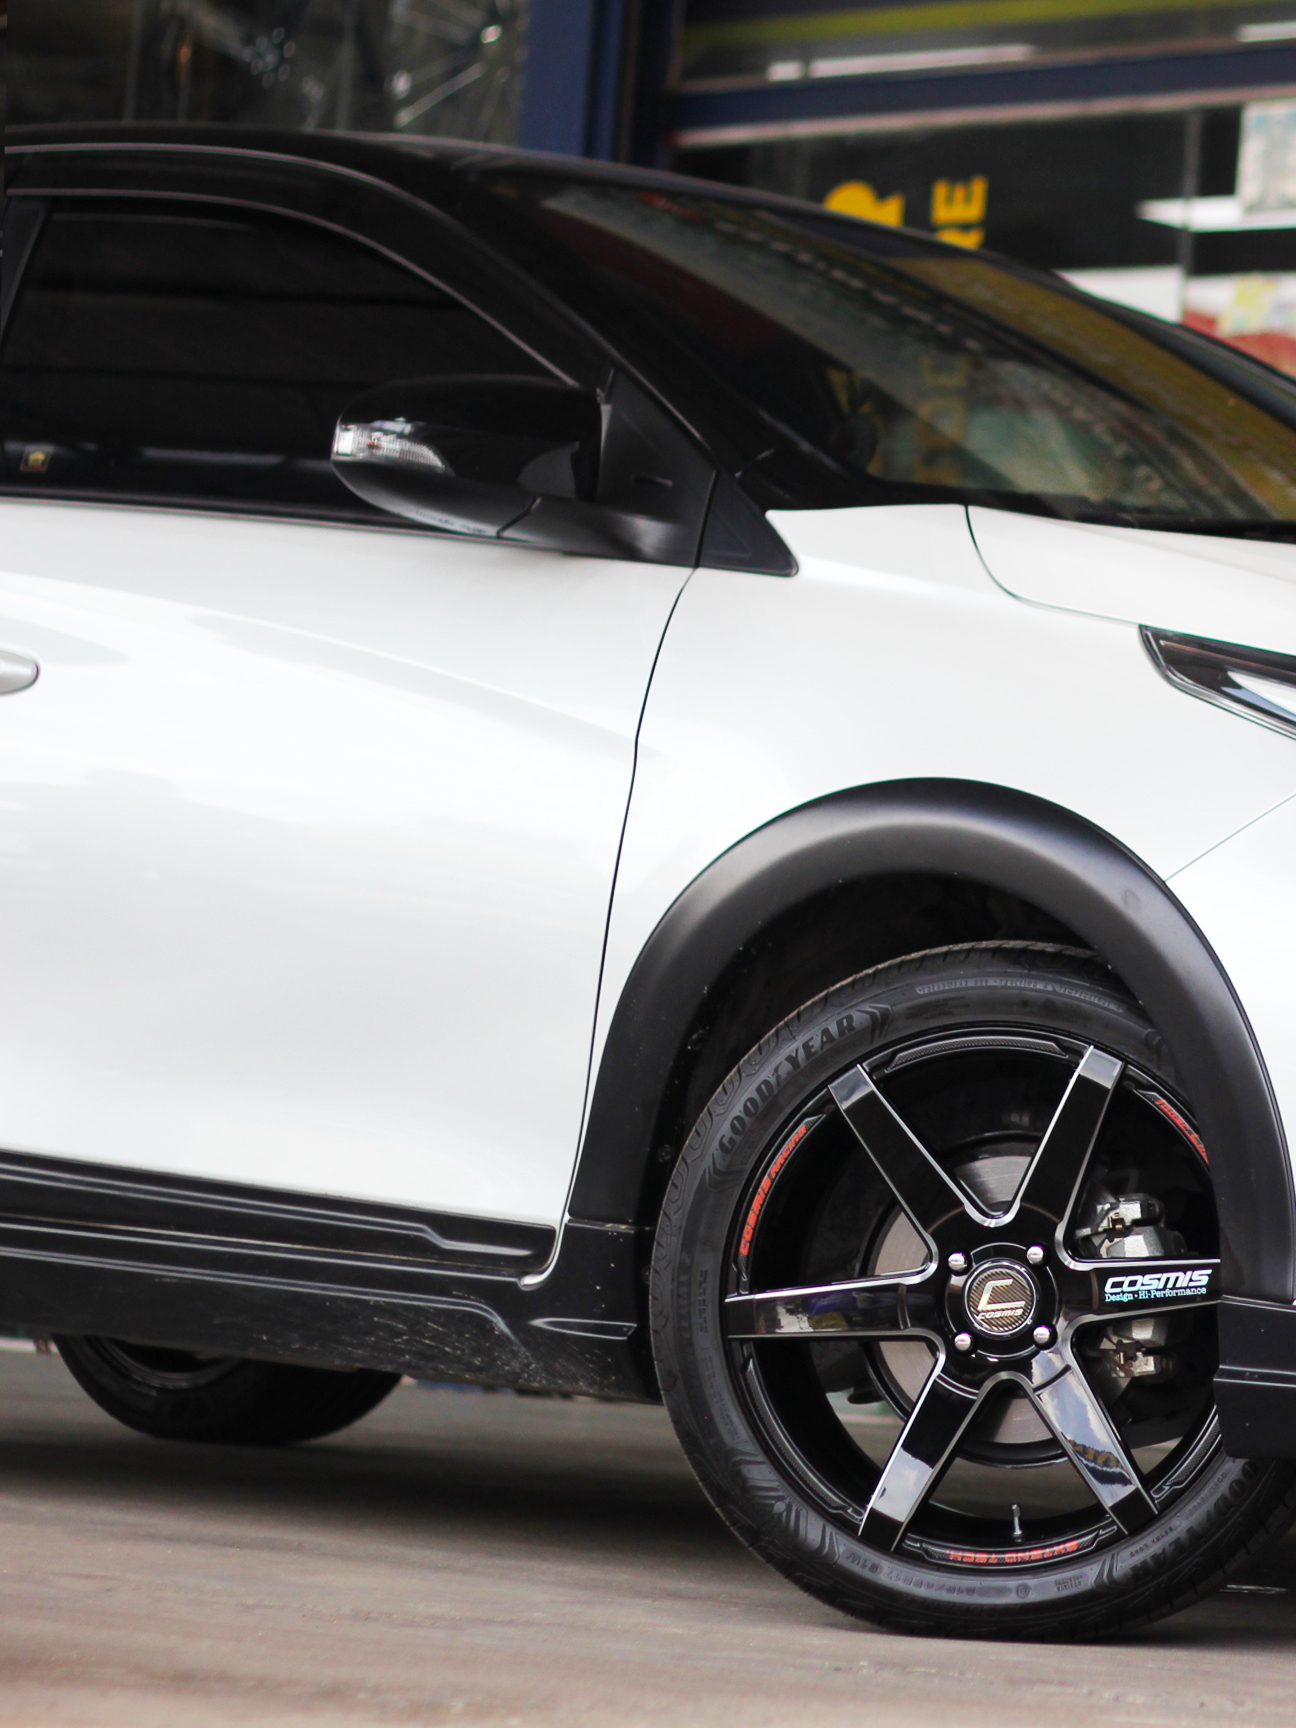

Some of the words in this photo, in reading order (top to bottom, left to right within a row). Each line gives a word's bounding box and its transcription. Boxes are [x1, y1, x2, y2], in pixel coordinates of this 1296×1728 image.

[719, 1013, 856, 1155] GOODYEAR
[1104, 1269, 1212, 1293] COSMIS
[1105, 1293, 1134, 1303] Design
[977, 1308, 1024, 1320] COSMIS
